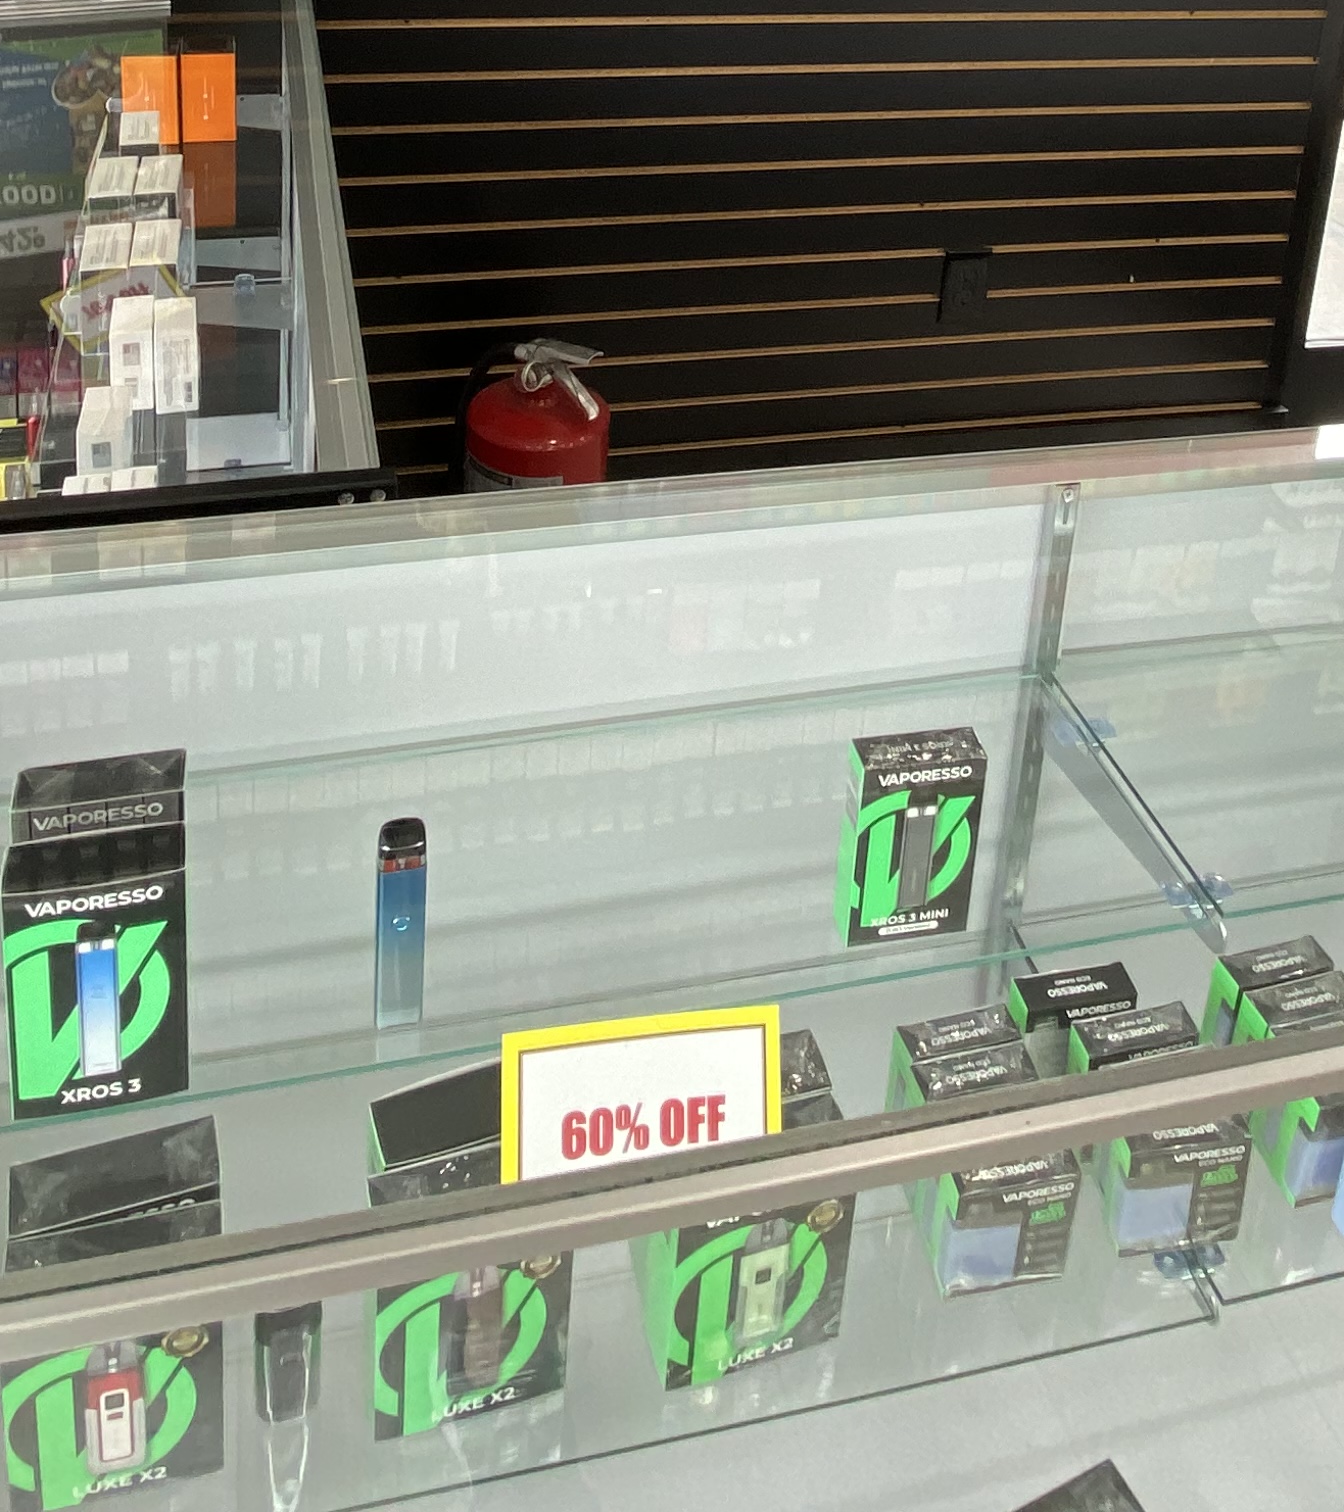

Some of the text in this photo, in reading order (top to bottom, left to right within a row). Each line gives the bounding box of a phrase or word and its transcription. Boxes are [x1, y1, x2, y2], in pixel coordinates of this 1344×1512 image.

[878, 766, 973, 788] VAPORESSO
[34, 802, 164, 832] VAPORESSO
[24, 885, 164, 918] VAPORESSO
[869, 913, 906, 928] XROS
[908, 913, 917, 924] 3
[919, 908, 949, 920] MINI
[1064, 1000, 1132, 1019] VAPORESSO
[61, 1079, 141, 1104] XROS 3
[561, 1094, 726, 1160] 60% OFF
[1173, 1145, 1246, 1164] VAPORESSO
[1002, 1182, 1075, 1203] VAPORESSO
[717, 1337, 794, 1371] LUXE X2
[490, 1386, 516, 1404] X2
[72, 1466, 167, 1500] LUXE X2
